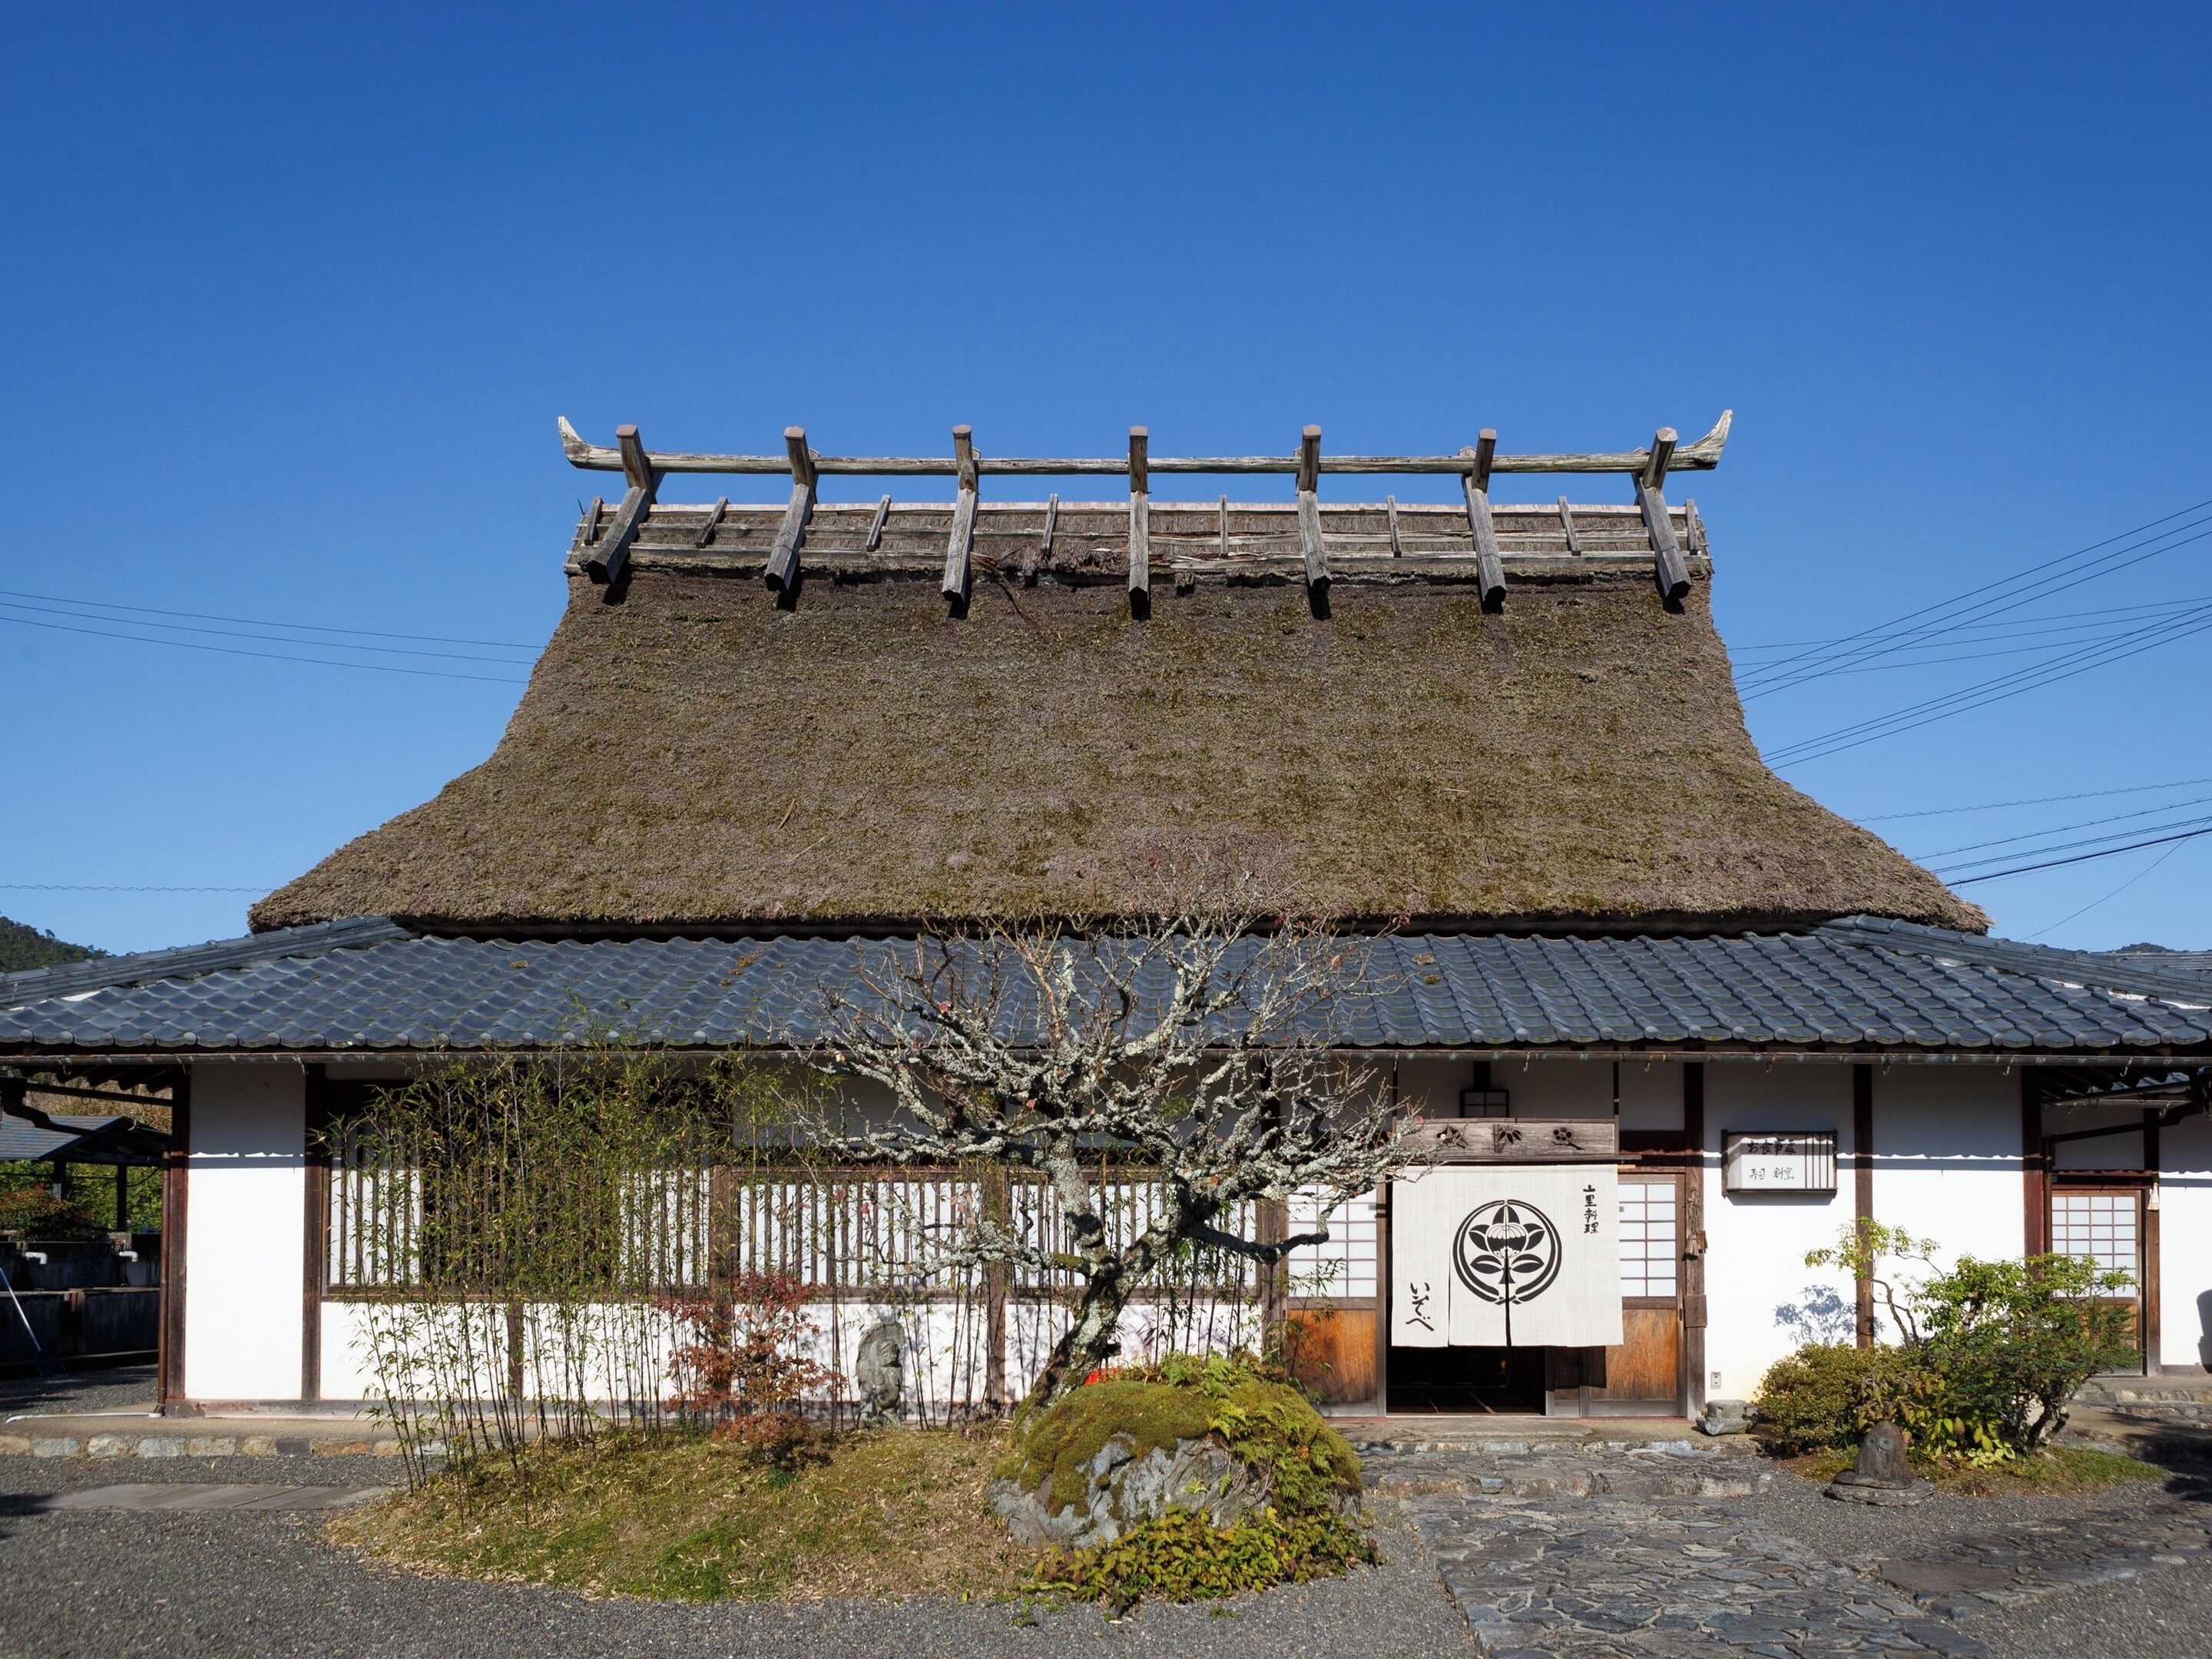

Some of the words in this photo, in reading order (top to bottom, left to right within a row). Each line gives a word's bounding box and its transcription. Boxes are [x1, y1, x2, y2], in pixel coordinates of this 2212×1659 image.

[1583, 1184, 1598, 1233] 山里料理
[1405, 1282, 1435, 1332] いそべ
